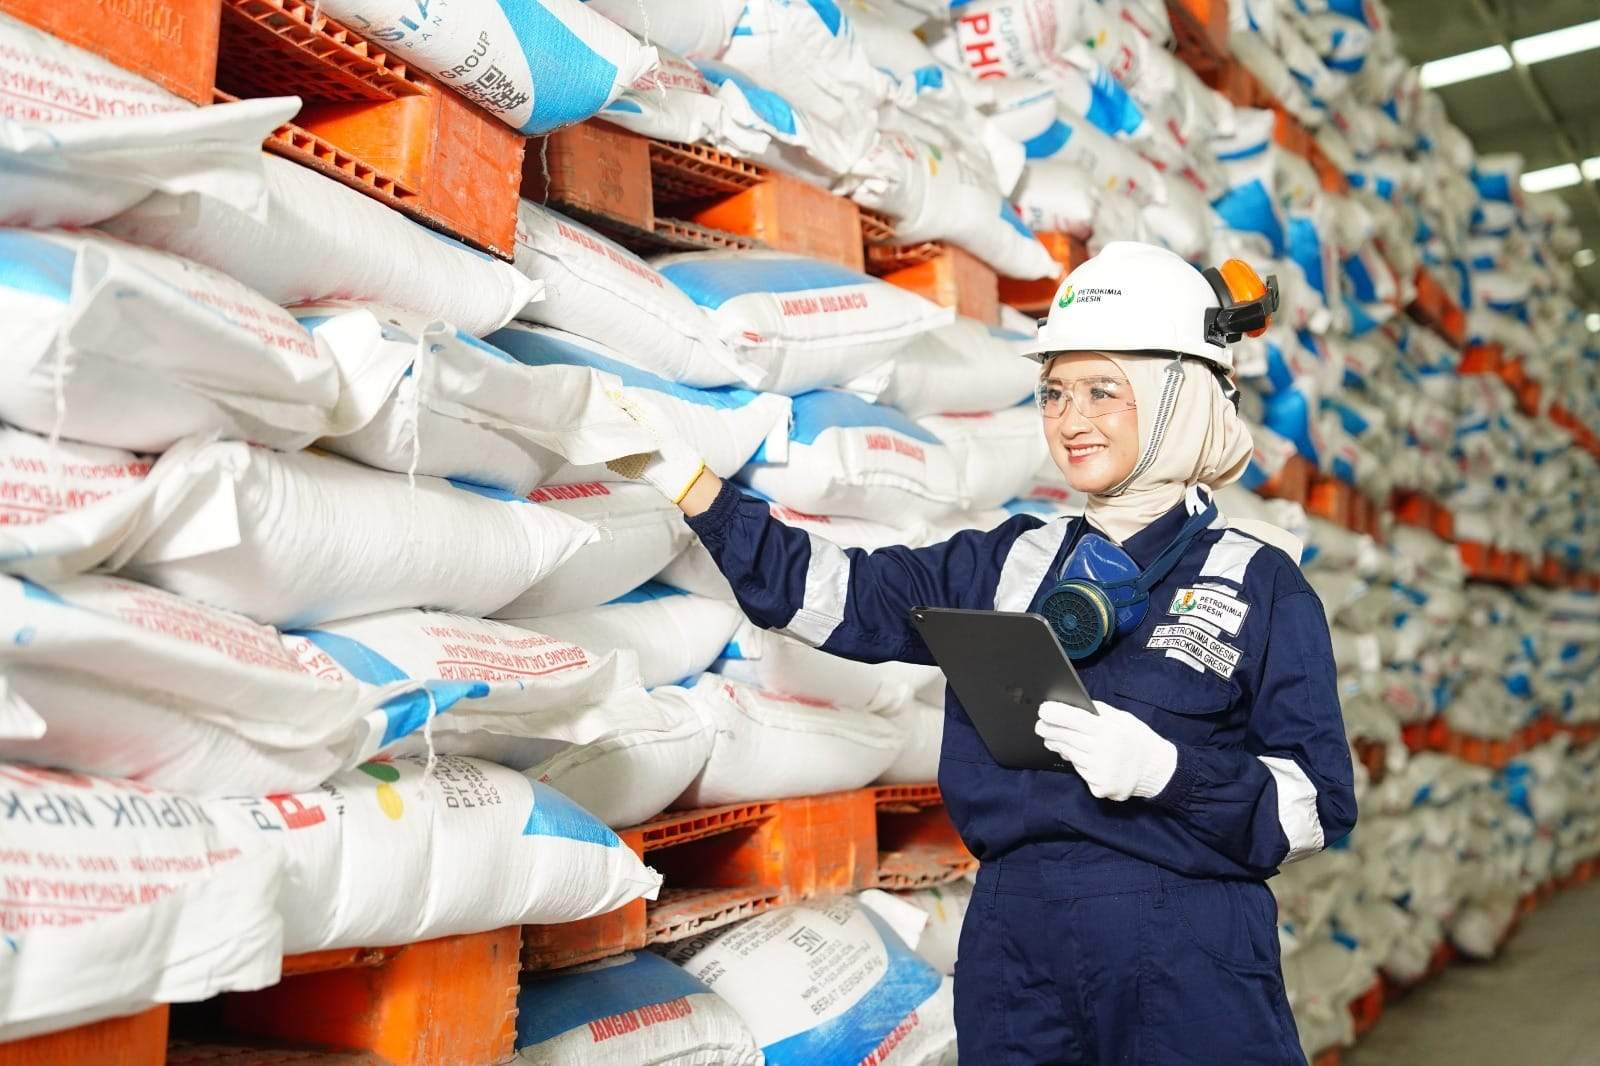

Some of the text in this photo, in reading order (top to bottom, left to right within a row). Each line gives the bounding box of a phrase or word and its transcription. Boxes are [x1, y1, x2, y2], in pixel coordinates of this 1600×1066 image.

[440, 31, 492, 79] GROUP
[1076, 295, 1102, 304] GRESIK
[1077, 288, 1122, 296] PETROKIMIA
[1196, 603, 1223, 619] GRESIK
[1199, 596, 1243, 618] PETROKIMIA
[442, 643, 586, 671] BARANG DALAM PENGAWASAN
[1151, 638, 1231, 675] PT. PETROKIMIA GRESIK
[1156, 626, 1237, 661] PT. PETROKIMIA GRESIK
[2, 790, 95, 828] NPK
[3, 876, 138, 905] PENGAWASAN
[793, 929, 823, 954] SNI
[810, 988, 839, 1016] BERAT
[588, 996, 693, 1043] JANGAN DIGANCU
[876, 1008, 920, 1060] DIGANCU
